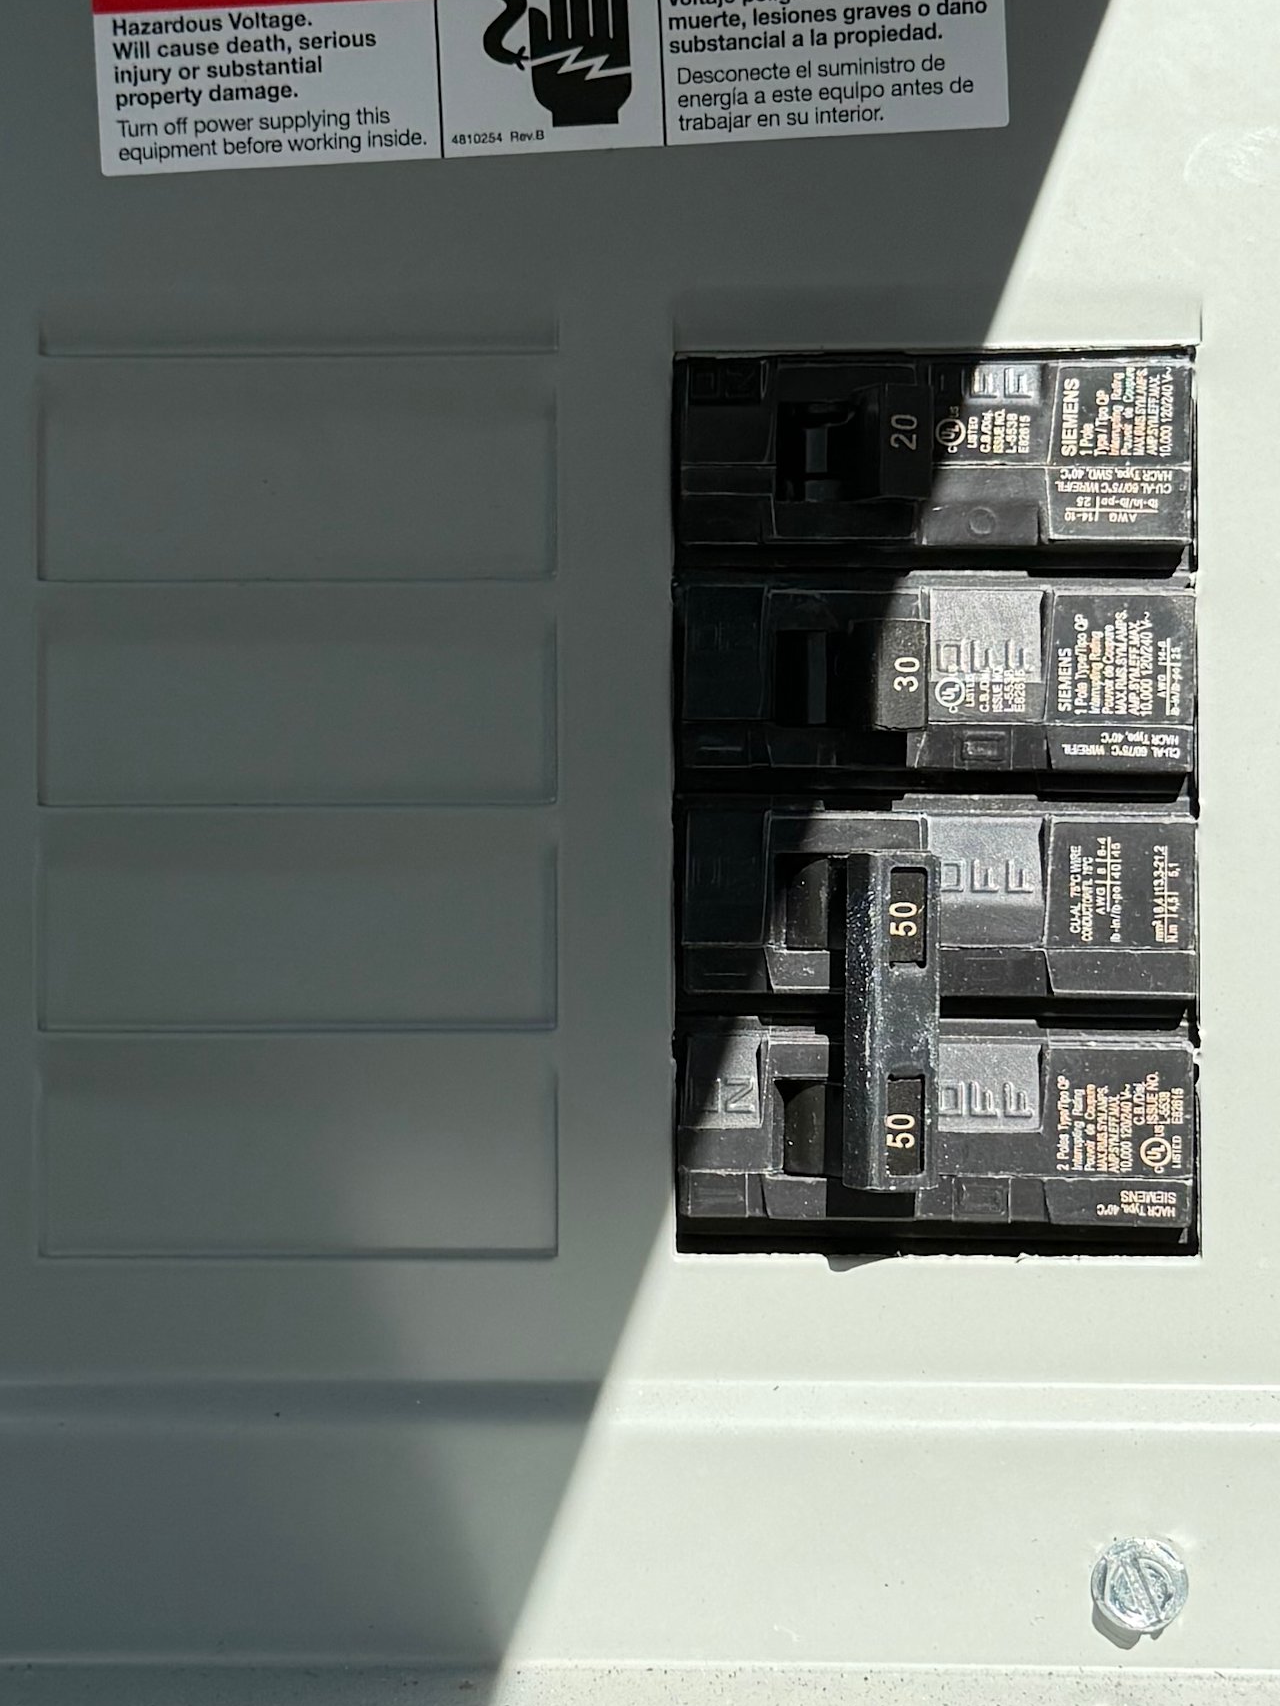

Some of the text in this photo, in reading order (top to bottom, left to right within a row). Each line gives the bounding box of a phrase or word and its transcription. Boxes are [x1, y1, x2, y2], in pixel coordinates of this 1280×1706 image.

[112, 11, 312, 35] Hazardous Voltage.
[668, 10, 746, 30] muerte,
[752, 6, 836, 25] lesiones
[842, 4, 911, 24] graves
[917, 3, 930, 16] o
[112, 30, 376, 59] Will cause death, serious
[669, 22, 942, 53] substancial a la propiedad.
[114, 55, 321, 86] injury or substantial
[677, 53, 945, 84] Desconecte el suministro de
[115, 84, 297, 110] property damage.
[677, 76, 973, 110] energía a este equipo antes de
[116, 106, 390, 137] Turn off power supplying this
[678, 104, 883, 132] trabajar en su interior.
[118, 128, 426, 164] equipment before working inside.
[451, 129, 544, 144] 4810254 Rev.B
[890, 414, 918, 450] 20
[941, 424, 959, 439] UL
[966, 416, 978, 448] LISTED
[1060, 377, 1079, 456] SIEMENS
[1079, 423, 1093, 447] Pole
[1075, 496, 1091, 506] 25
[892, 656, 920, 692] 30
[1057, 647, 1072, 711] SIEMENS
[941, 683, 960, 700] UL
[1110, 863, 1121, 879] 40
[1095, 886, 1105, 914] AWG
[889, 901, 918, 938] 50
[1146, 1070, 1159, 1124] ISSUE NO.
[886, 1113, 916, 1149] 50
[1171, 1134, 1181, 1168] LISTED
[1119, 1189, 1176, 1203] SIEMENS
